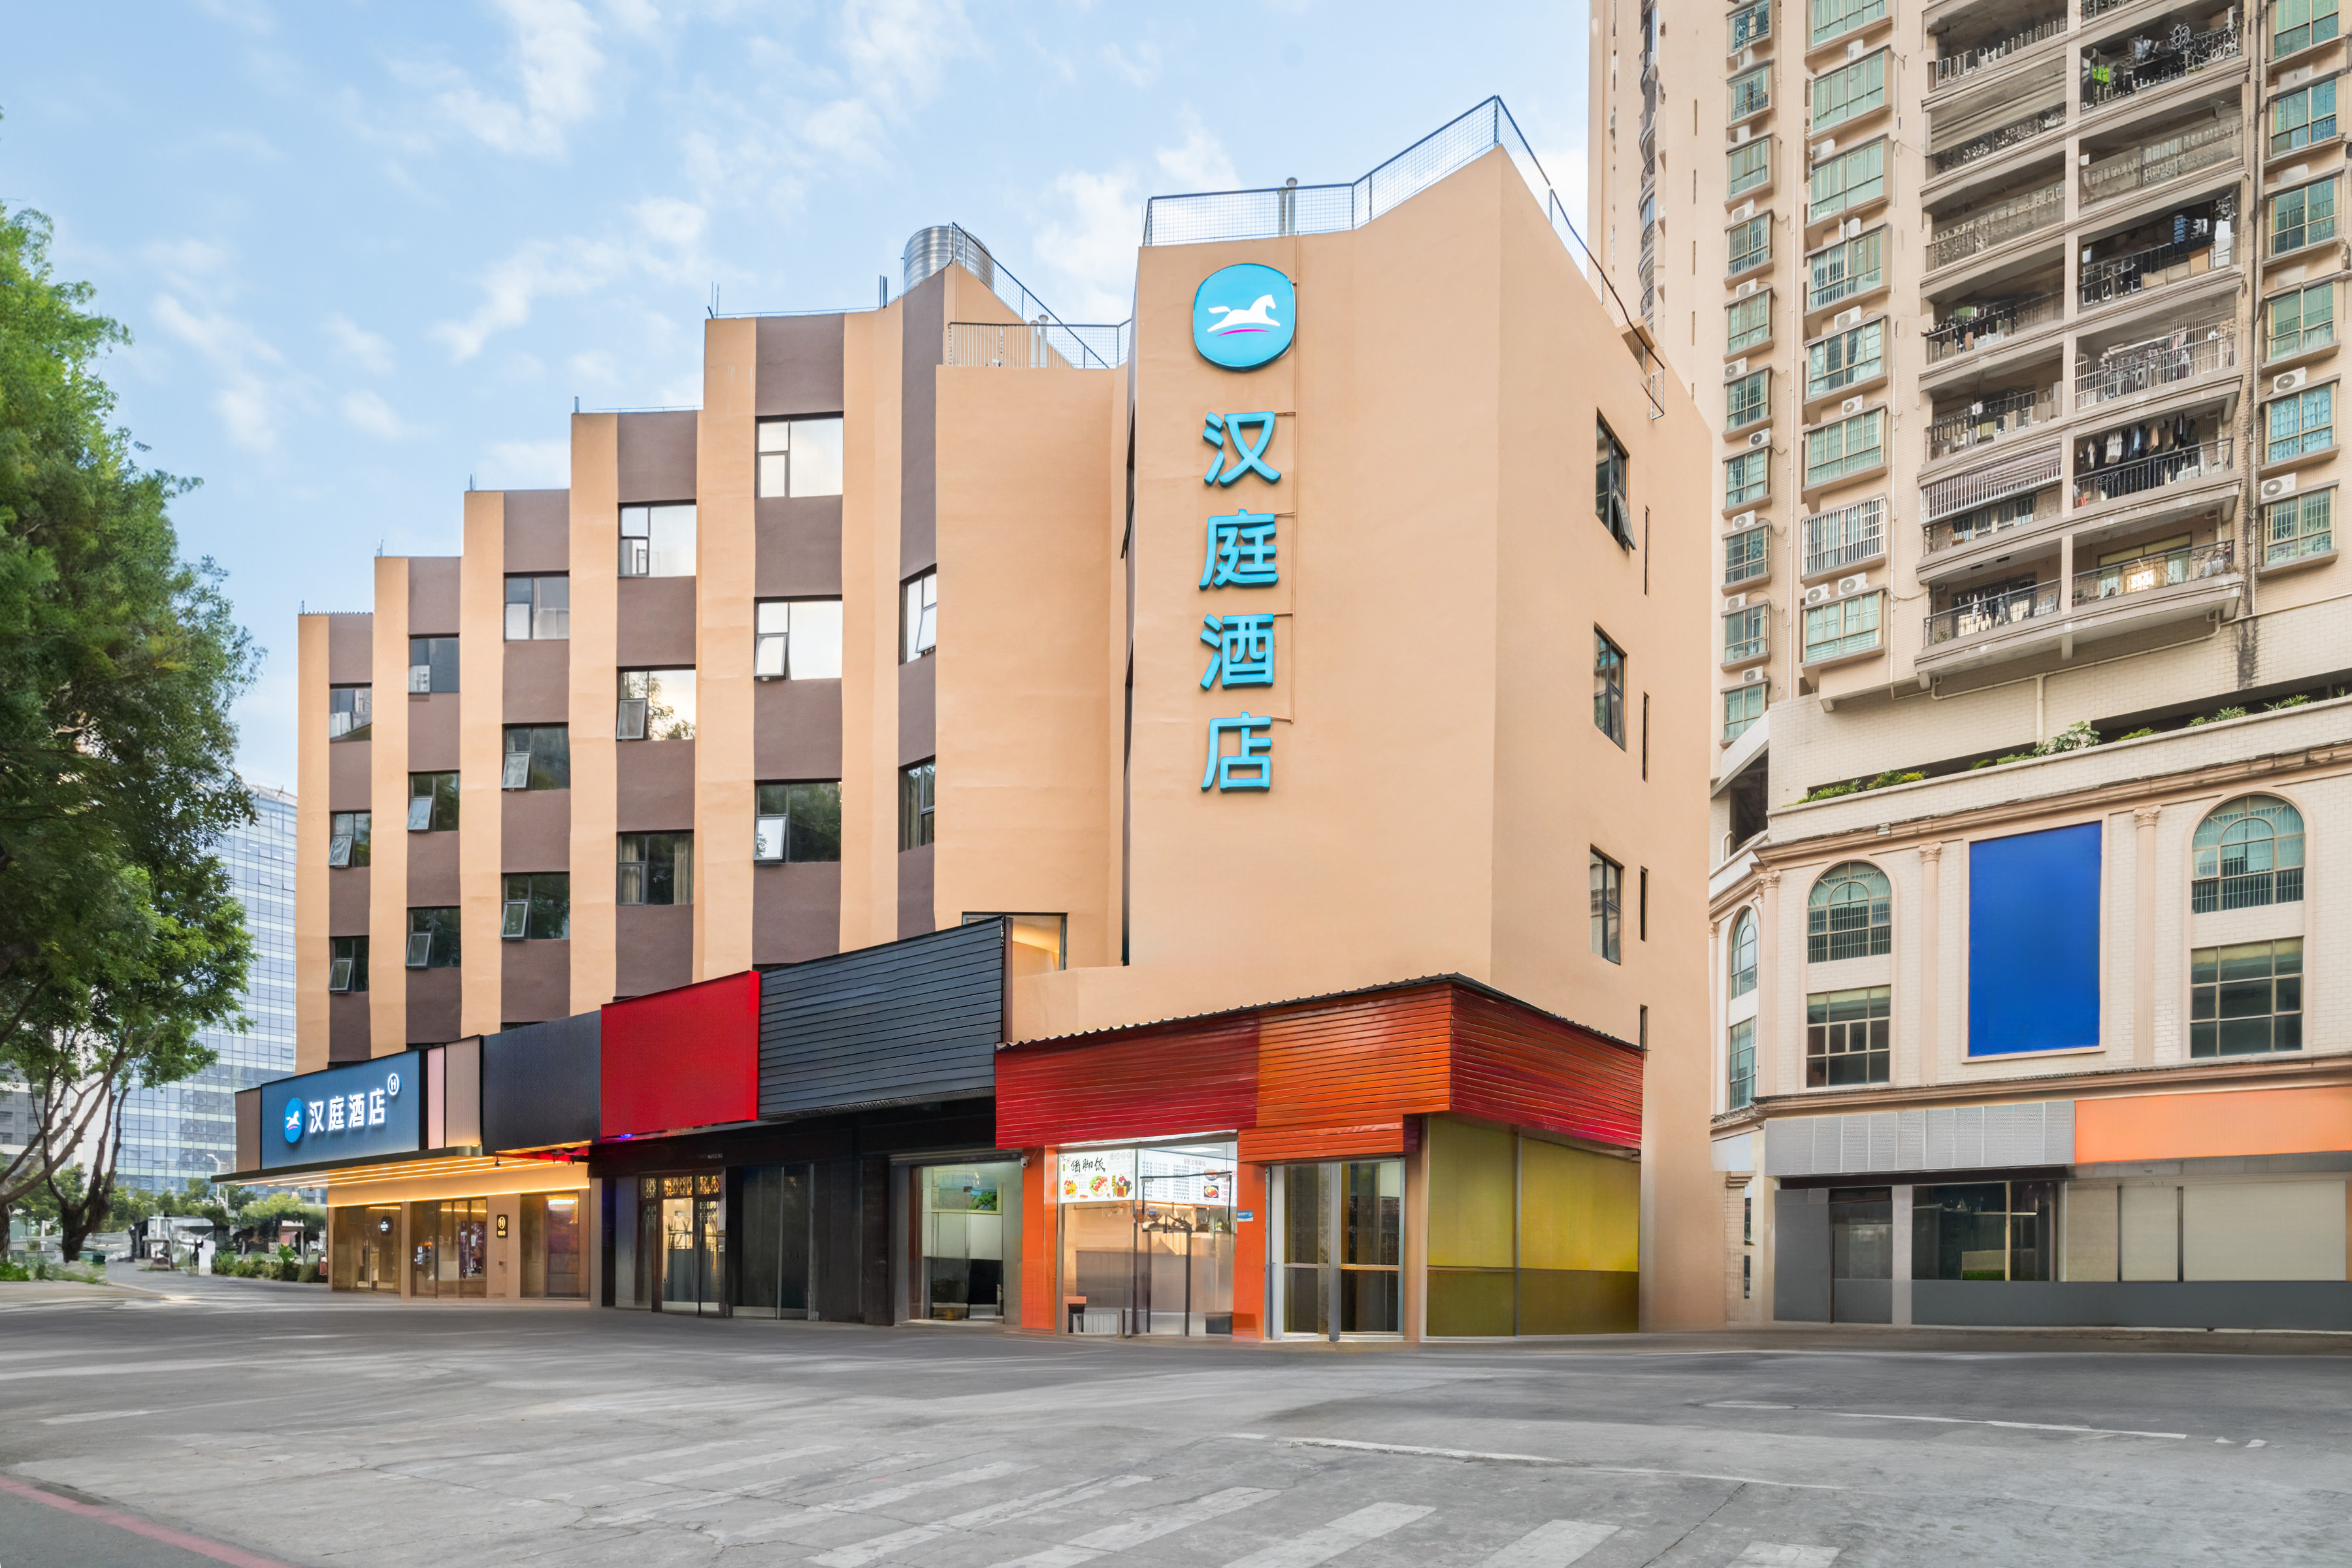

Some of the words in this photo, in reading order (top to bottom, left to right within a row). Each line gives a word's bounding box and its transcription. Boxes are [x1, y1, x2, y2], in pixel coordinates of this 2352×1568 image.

[1199, 411, 1282, 792] 汉庭酒店
[308, 1088, 386, 1134] 汉庭酒店
[1070, 1157, 1105, 1173] 猪脚饭
